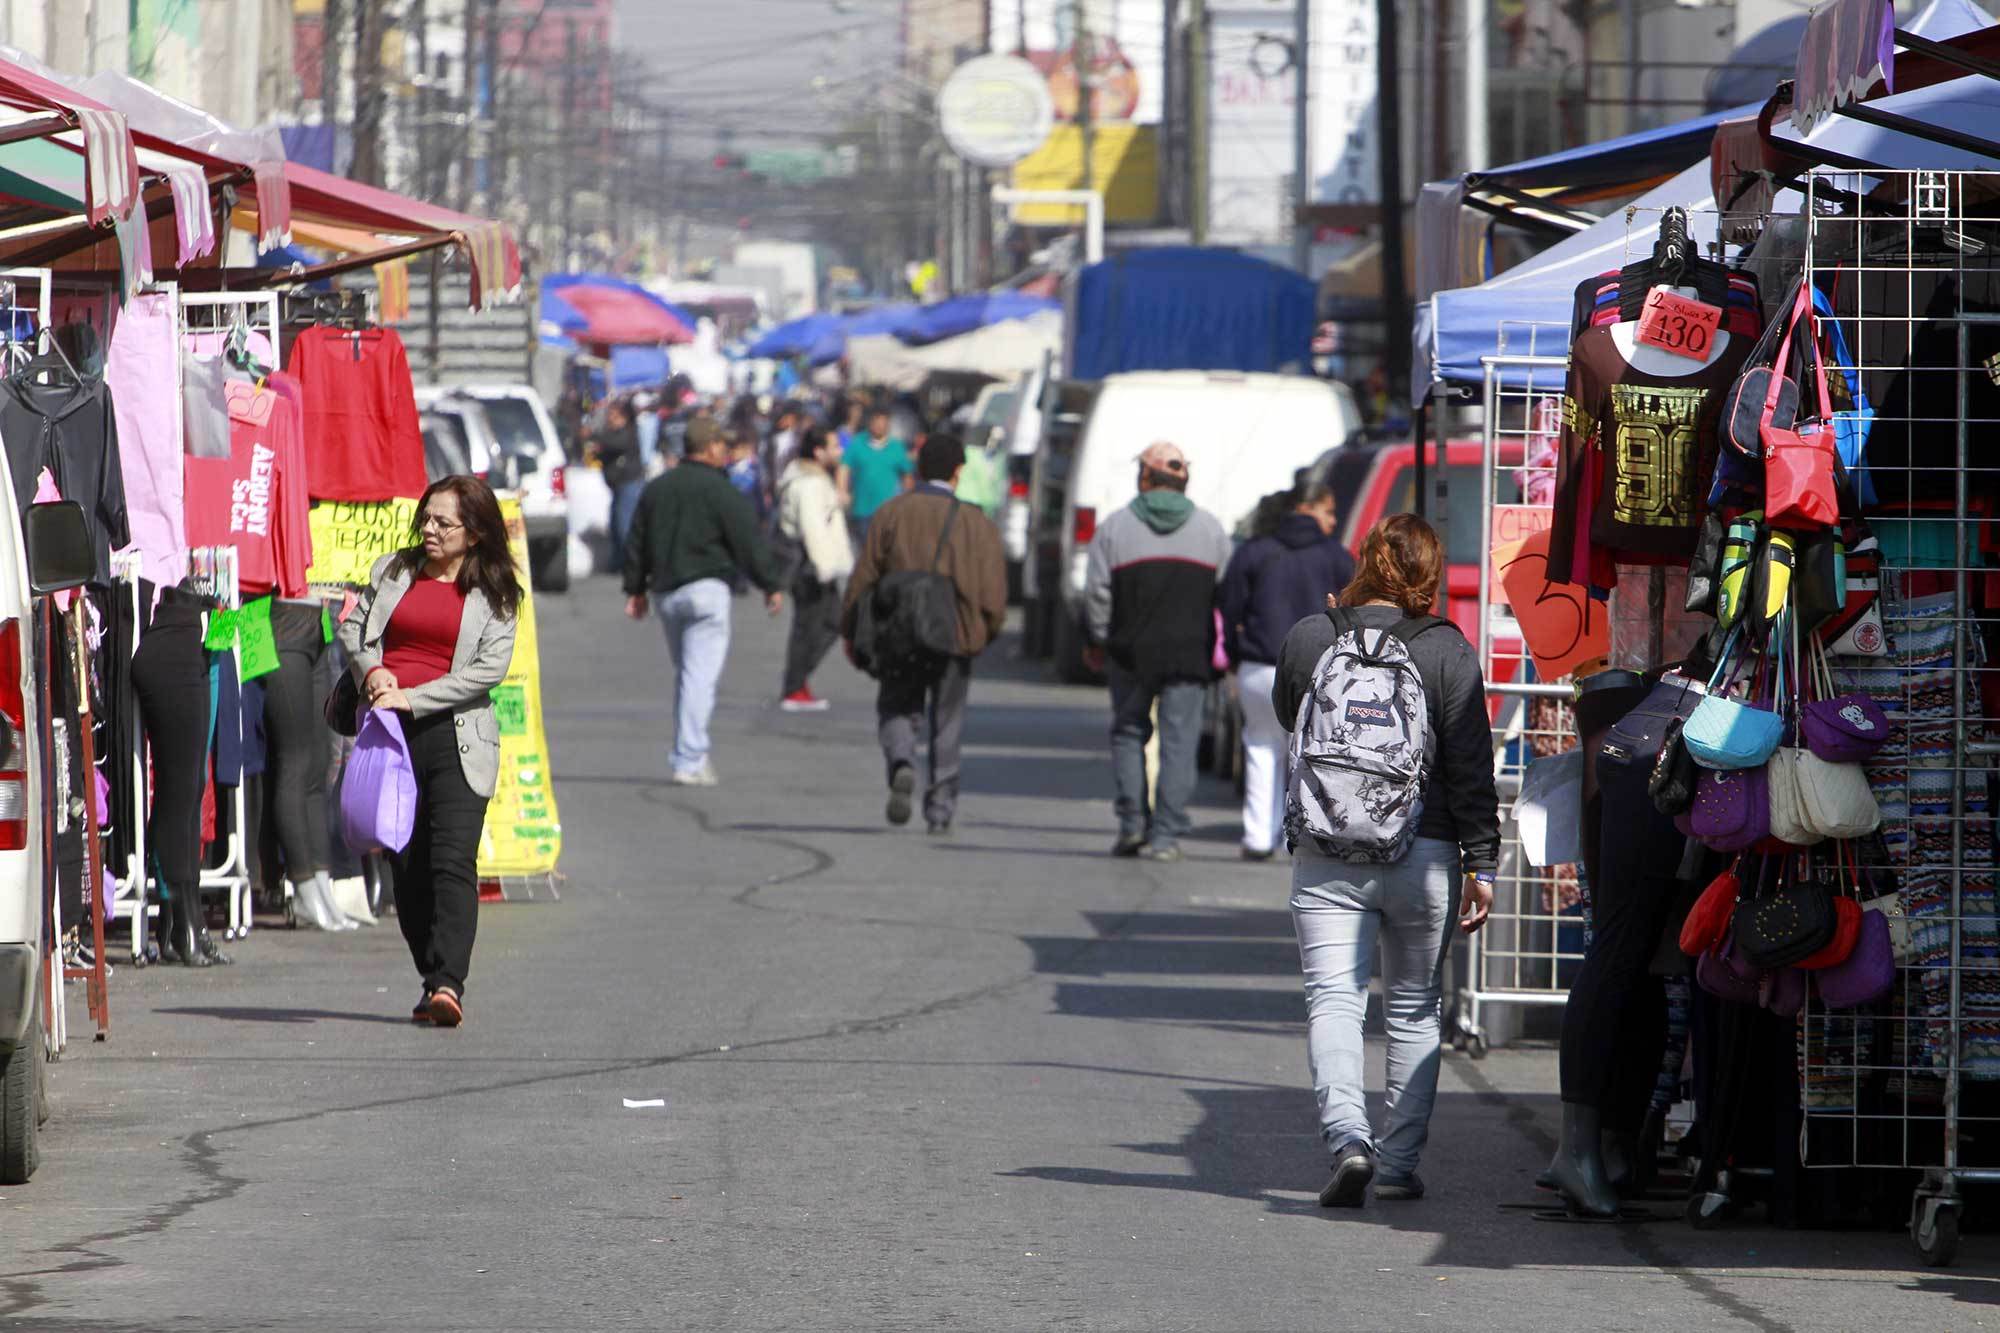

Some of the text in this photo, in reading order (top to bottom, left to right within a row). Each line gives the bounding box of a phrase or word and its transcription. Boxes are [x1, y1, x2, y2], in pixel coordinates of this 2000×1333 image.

[1341, 0, 1367, 204] AMIENTO
[1648, 292, 1665, 310] 2
[1650, 315, 1707, 352] 130
